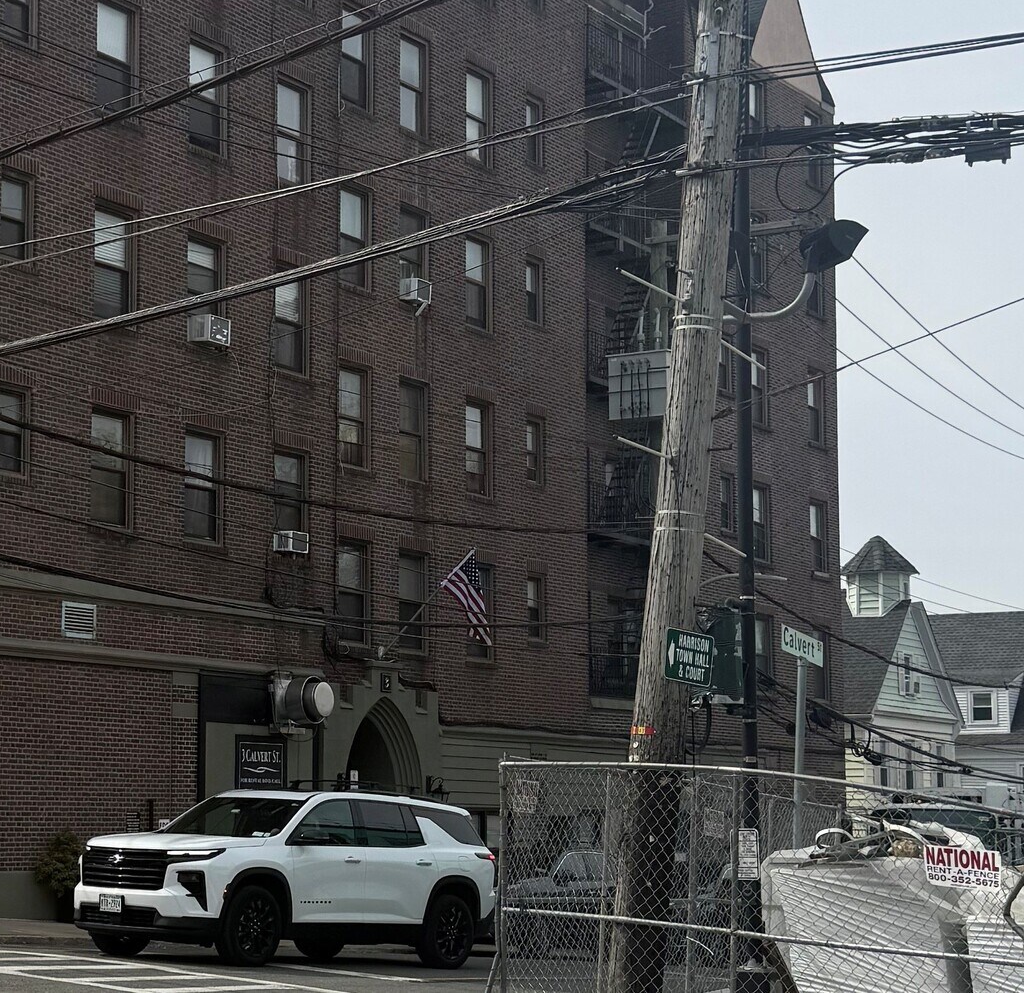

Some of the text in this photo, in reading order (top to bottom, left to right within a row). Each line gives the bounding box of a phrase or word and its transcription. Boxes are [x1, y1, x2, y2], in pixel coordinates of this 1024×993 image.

[678, 634, 710, 653] HARRISON
[783, 626, 815, 658] Calvert
[676, 648, 709, 667] TOWN HALL
[678, 664, 705, 682] & COURT
[241, 749, 281, 763] 3 CALVERT ST.
[925, 845, 1000, 873] NATIONAL
[927, 866, 1000, 880] RENT-A-FENCE
[928, 873, 1000, 888] 800-352-5675
